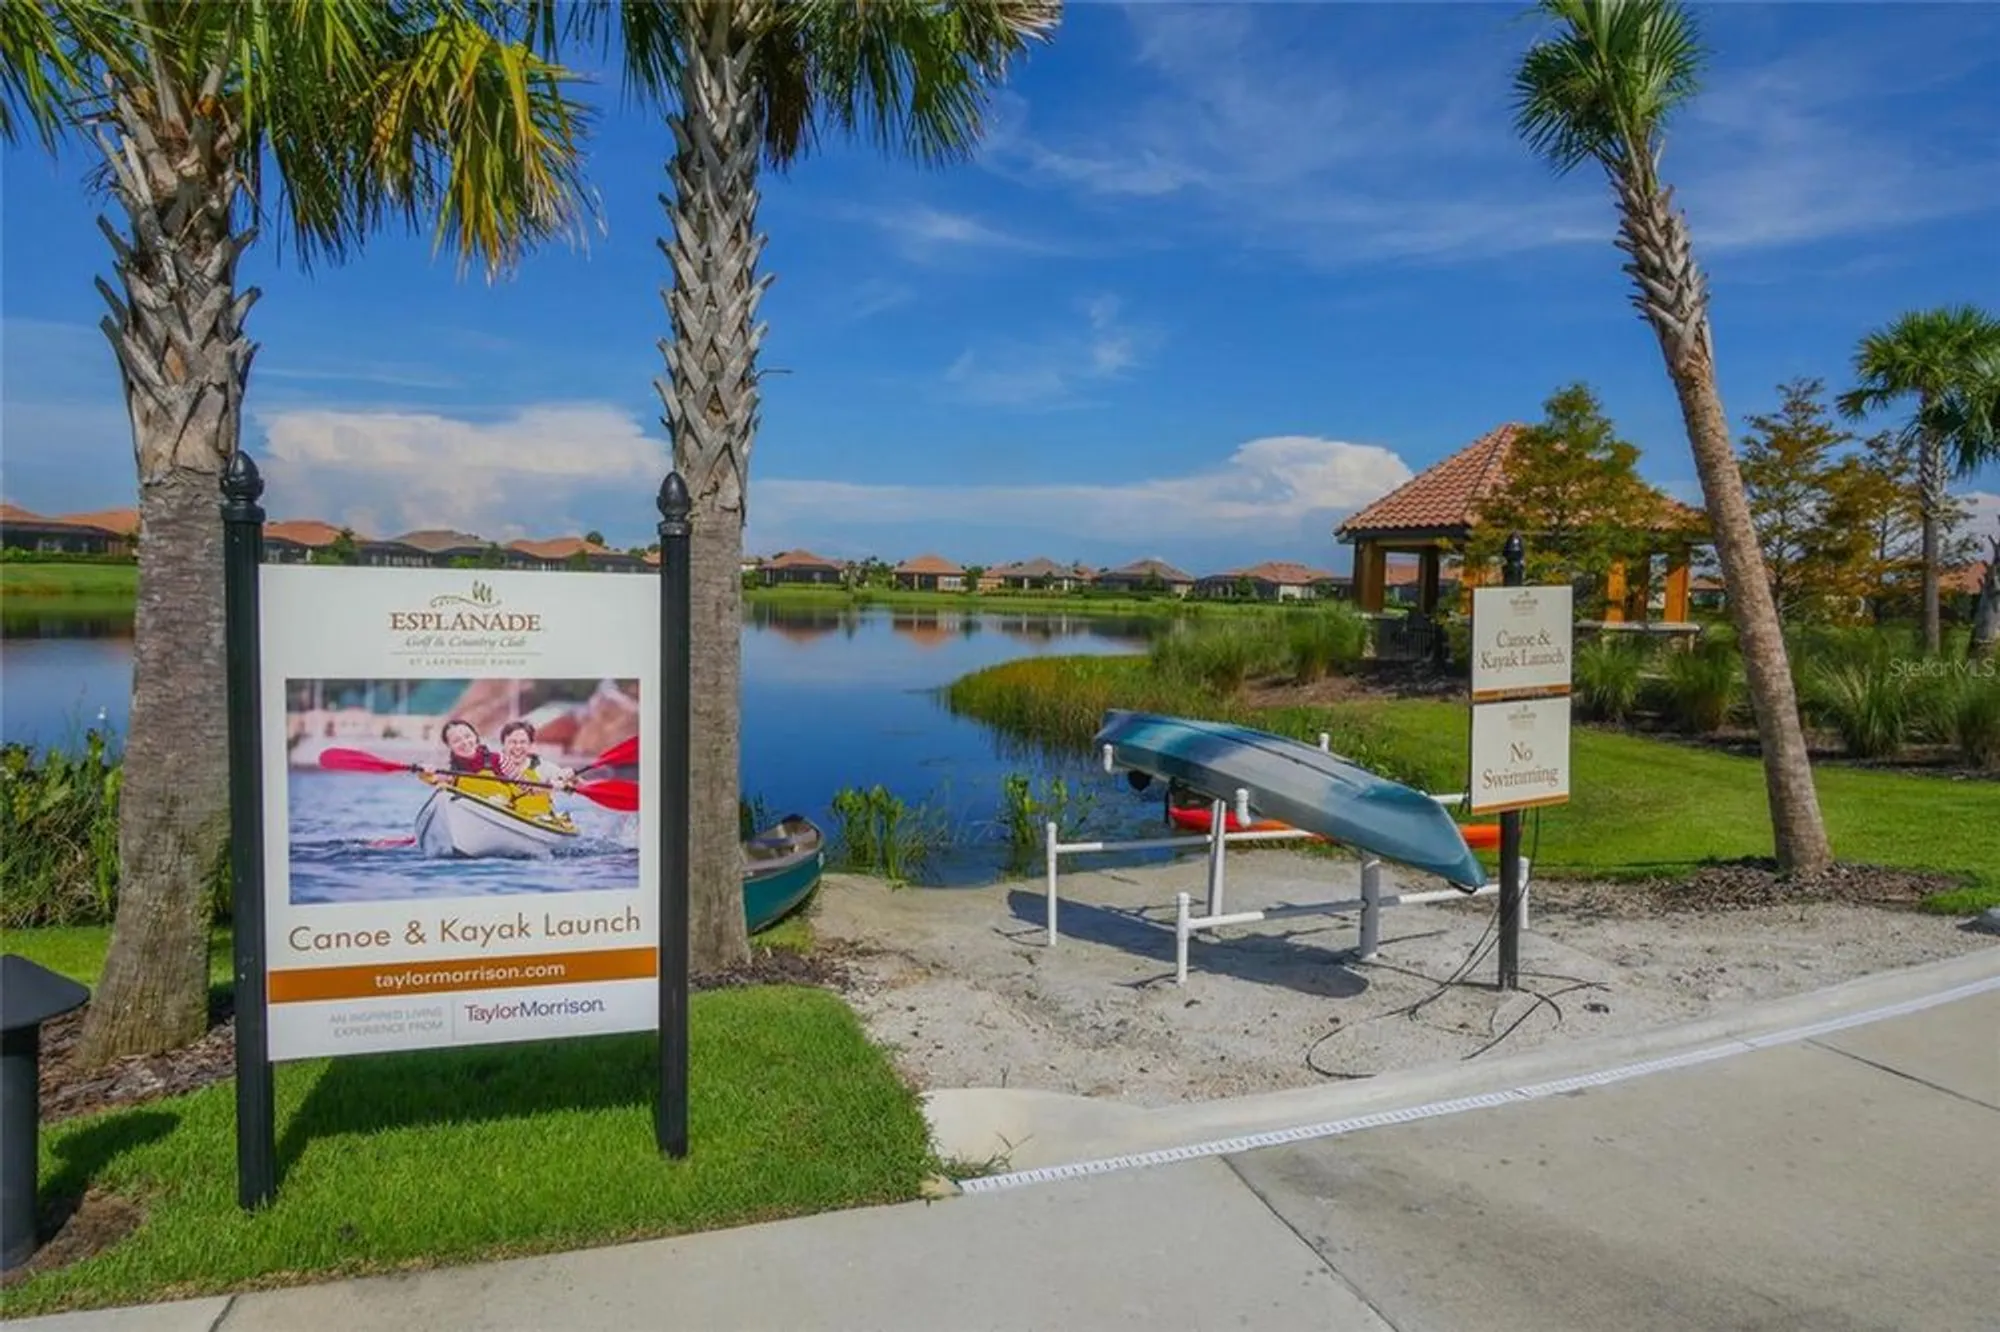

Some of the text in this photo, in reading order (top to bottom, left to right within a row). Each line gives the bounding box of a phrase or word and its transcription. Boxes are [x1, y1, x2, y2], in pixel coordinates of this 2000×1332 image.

[389, 612, 541, 632] ESPLANADE
[406, 635, 434, 649] Golf
[448, 635, 498, 649] Country
[500, 635, 527, 648] Club
[1496, 627, 1552, 648] Canoe &
[1480, 646, 1566, 673] Kayak Launch
[1508, 741, 1533, 764] No
[1482, 765, 1559, 790] Swimming
[289, 905, 641, 951] Canoe & Kayak Launch
[374, 962, 566, 989] taylormorrison.com
[464, 998, 605, 1025] TaylorMorrison
